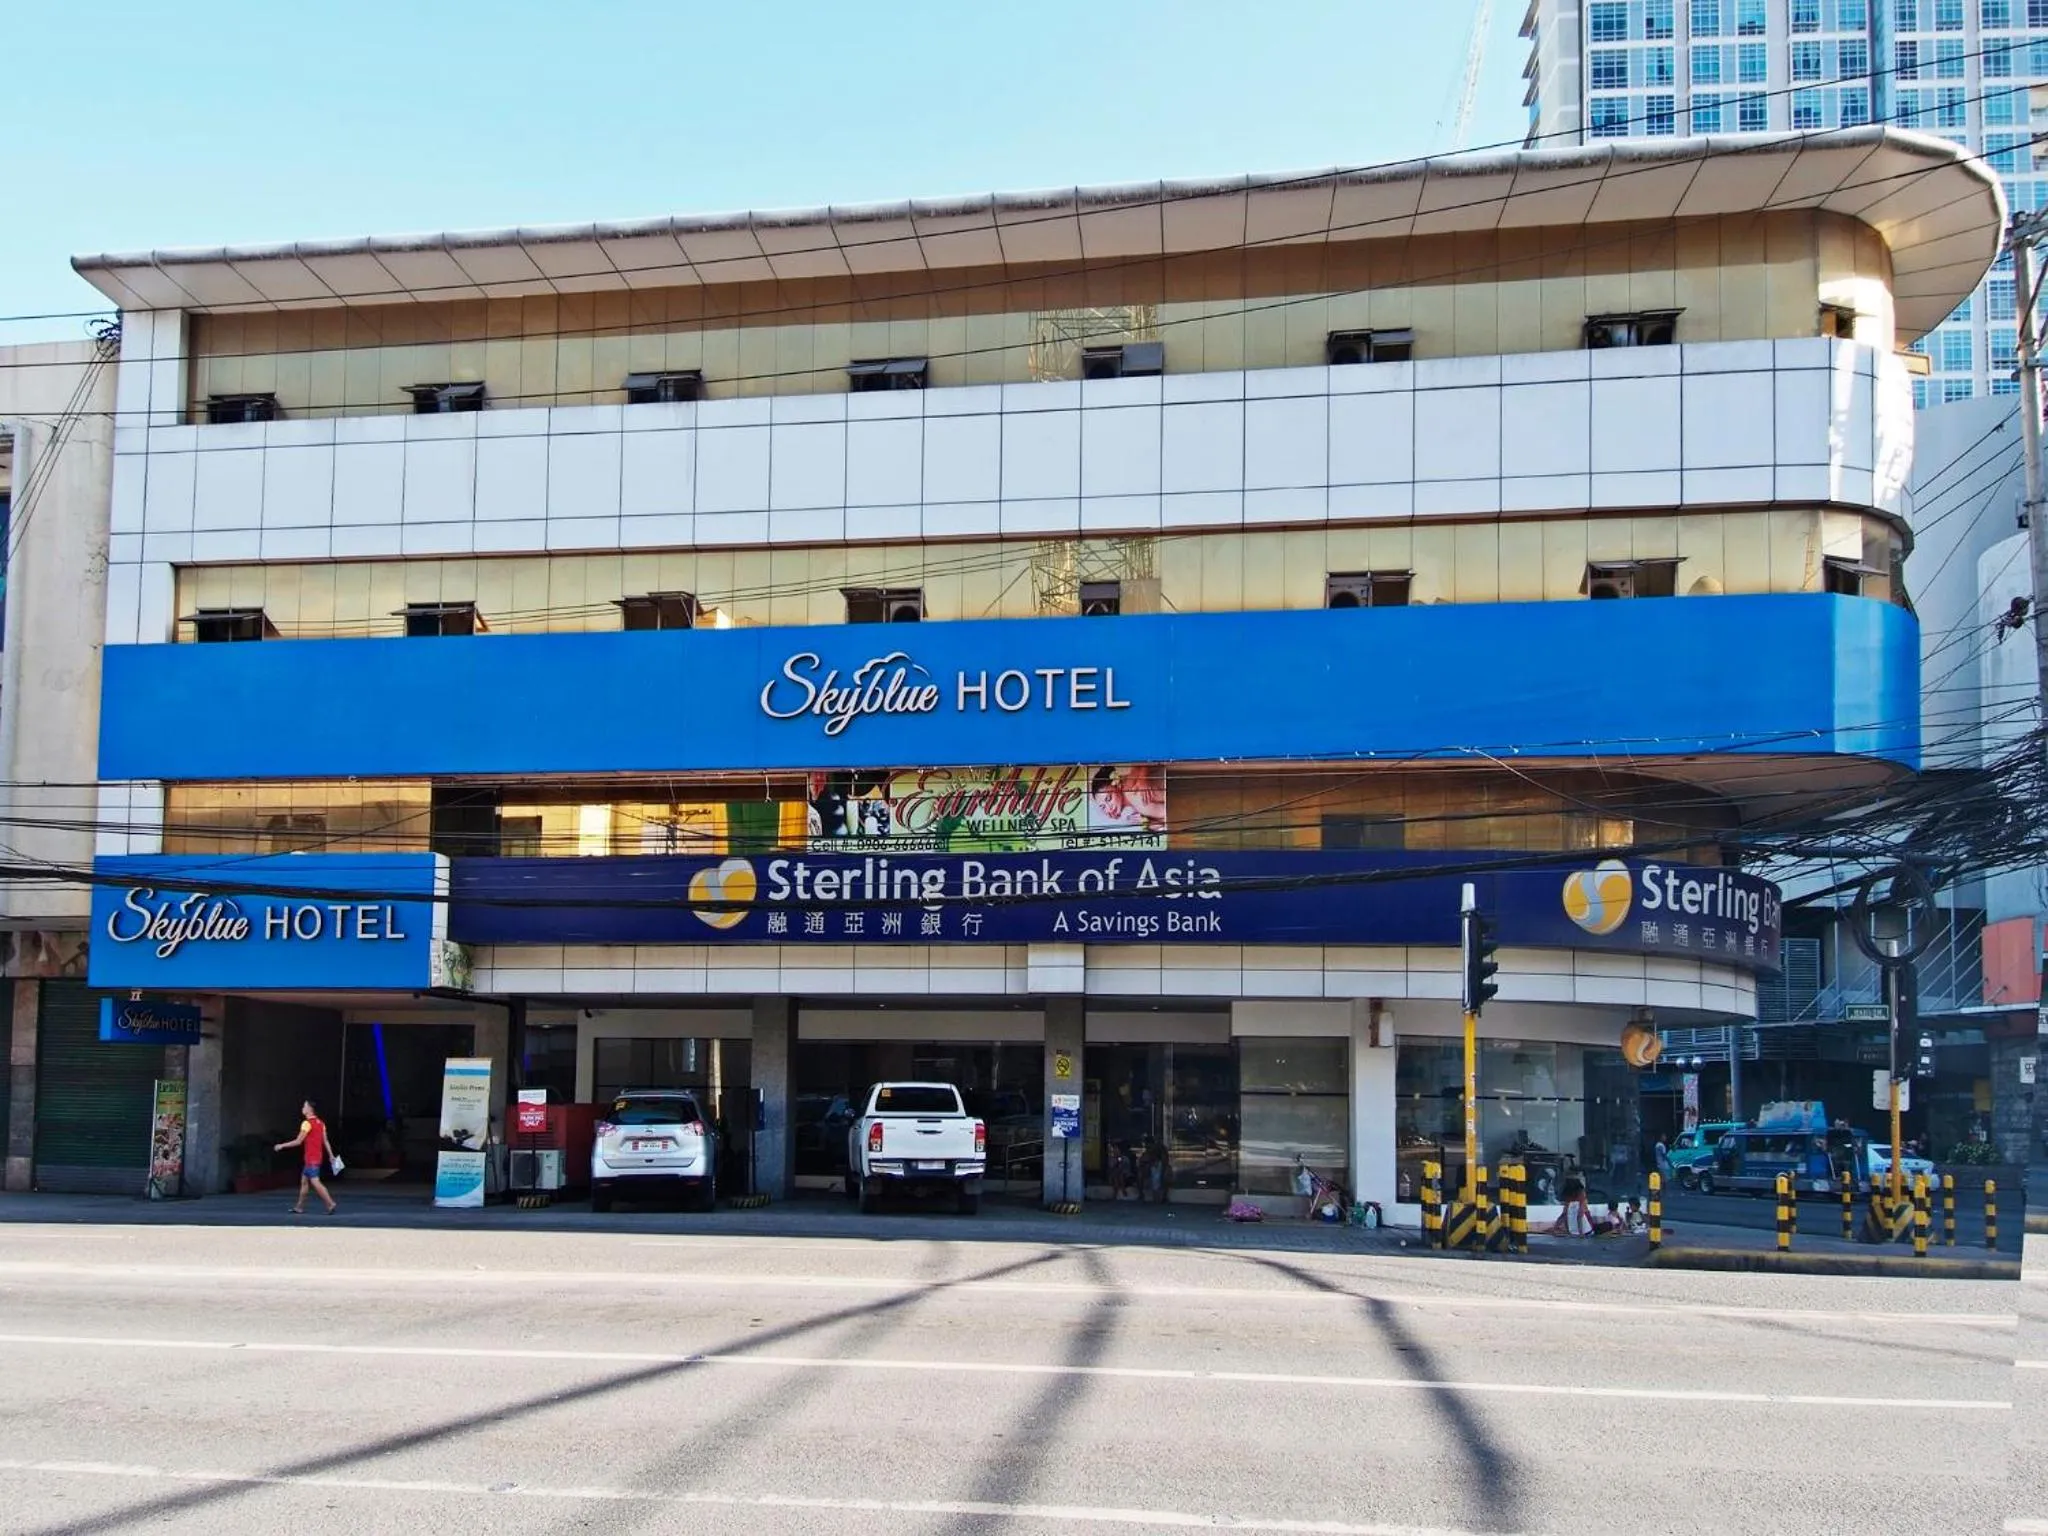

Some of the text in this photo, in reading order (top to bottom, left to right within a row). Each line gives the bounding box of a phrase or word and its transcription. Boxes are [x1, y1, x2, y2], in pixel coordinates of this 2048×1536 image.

[760, 651, 1131, 736] Skyblue HOTEL
[881, 766, 1082, 833] Earthlife
[811, 839, 837, 851] Cell
[966, 817, 1076, 833] WELLNESS SPA
[768, 857, 1222, 911] Sterling Bank of Asia
[1641, 865, 1760, 934] Sterling
[107, 886, 405, 959] Skyblue HOTEL
[768, 911, 984, 936] 融通亞洲銀行
[1053, 910, 1222, 937] A Savings Bank
[161, 1017, 199, 1032] HOTEL
